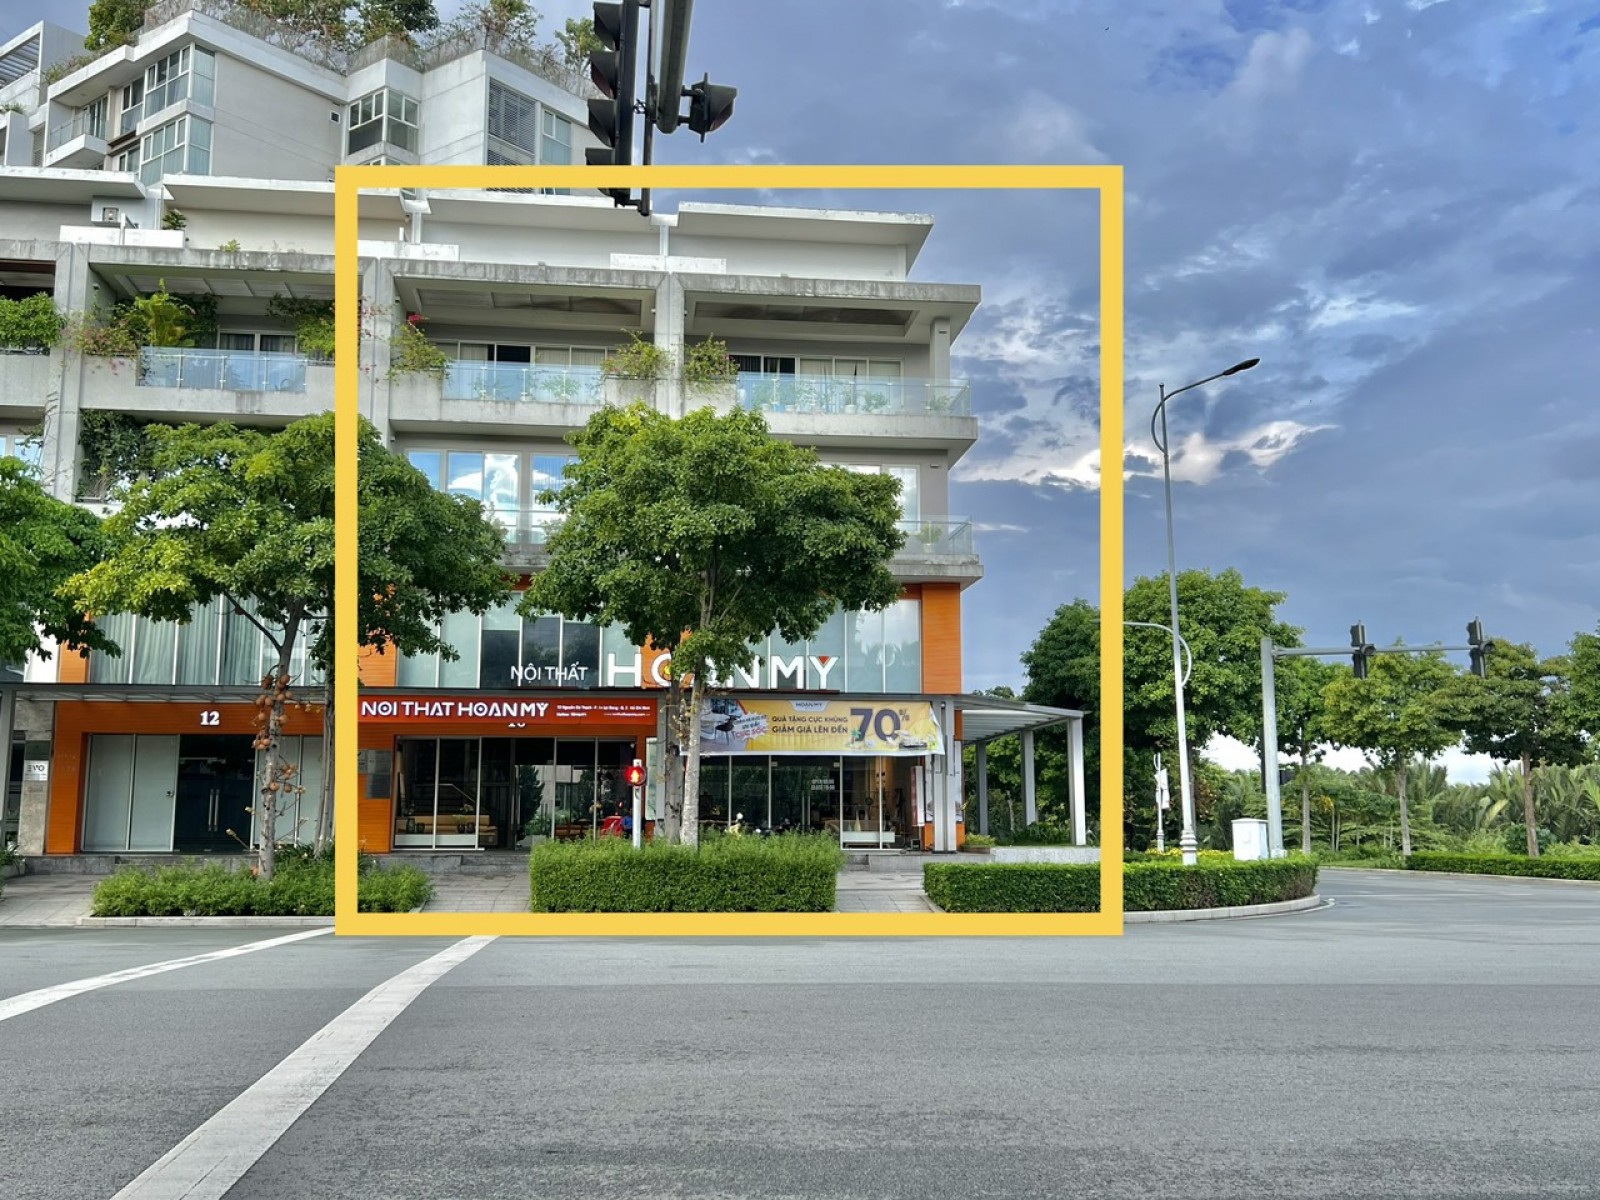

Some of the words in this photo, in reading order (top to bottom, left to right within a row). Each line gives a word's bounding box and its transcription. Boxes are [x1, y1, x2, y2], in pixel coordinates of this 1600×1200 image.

[510, 662, 541, 684] NỘI
[545, 661, 589, 681] THẤT
[362, 701, 397, 716] NOI
[401, 702, 454, 717] THAT
[200, 710, 220, 726] 12
